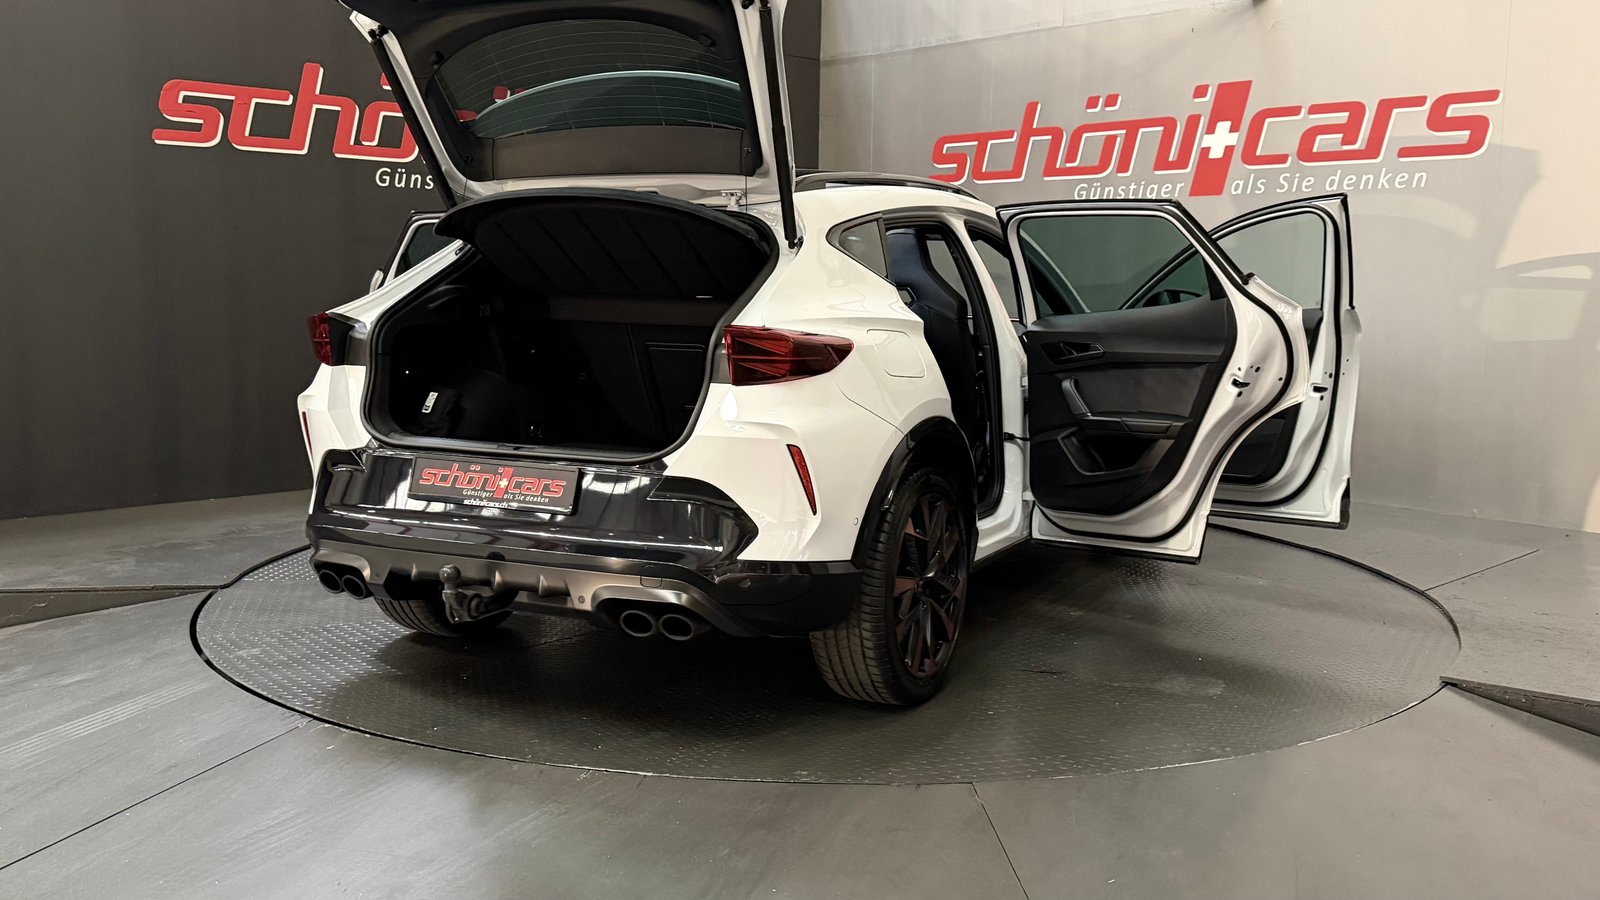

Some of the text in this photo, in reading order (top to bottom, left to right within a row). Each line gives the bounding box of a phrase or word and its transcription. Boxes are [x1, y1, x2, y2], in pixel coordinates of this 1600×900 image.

[375, 167, 434, 190] Güns
[1074, 167, 1427, 200] Günstiger als Sie denken
